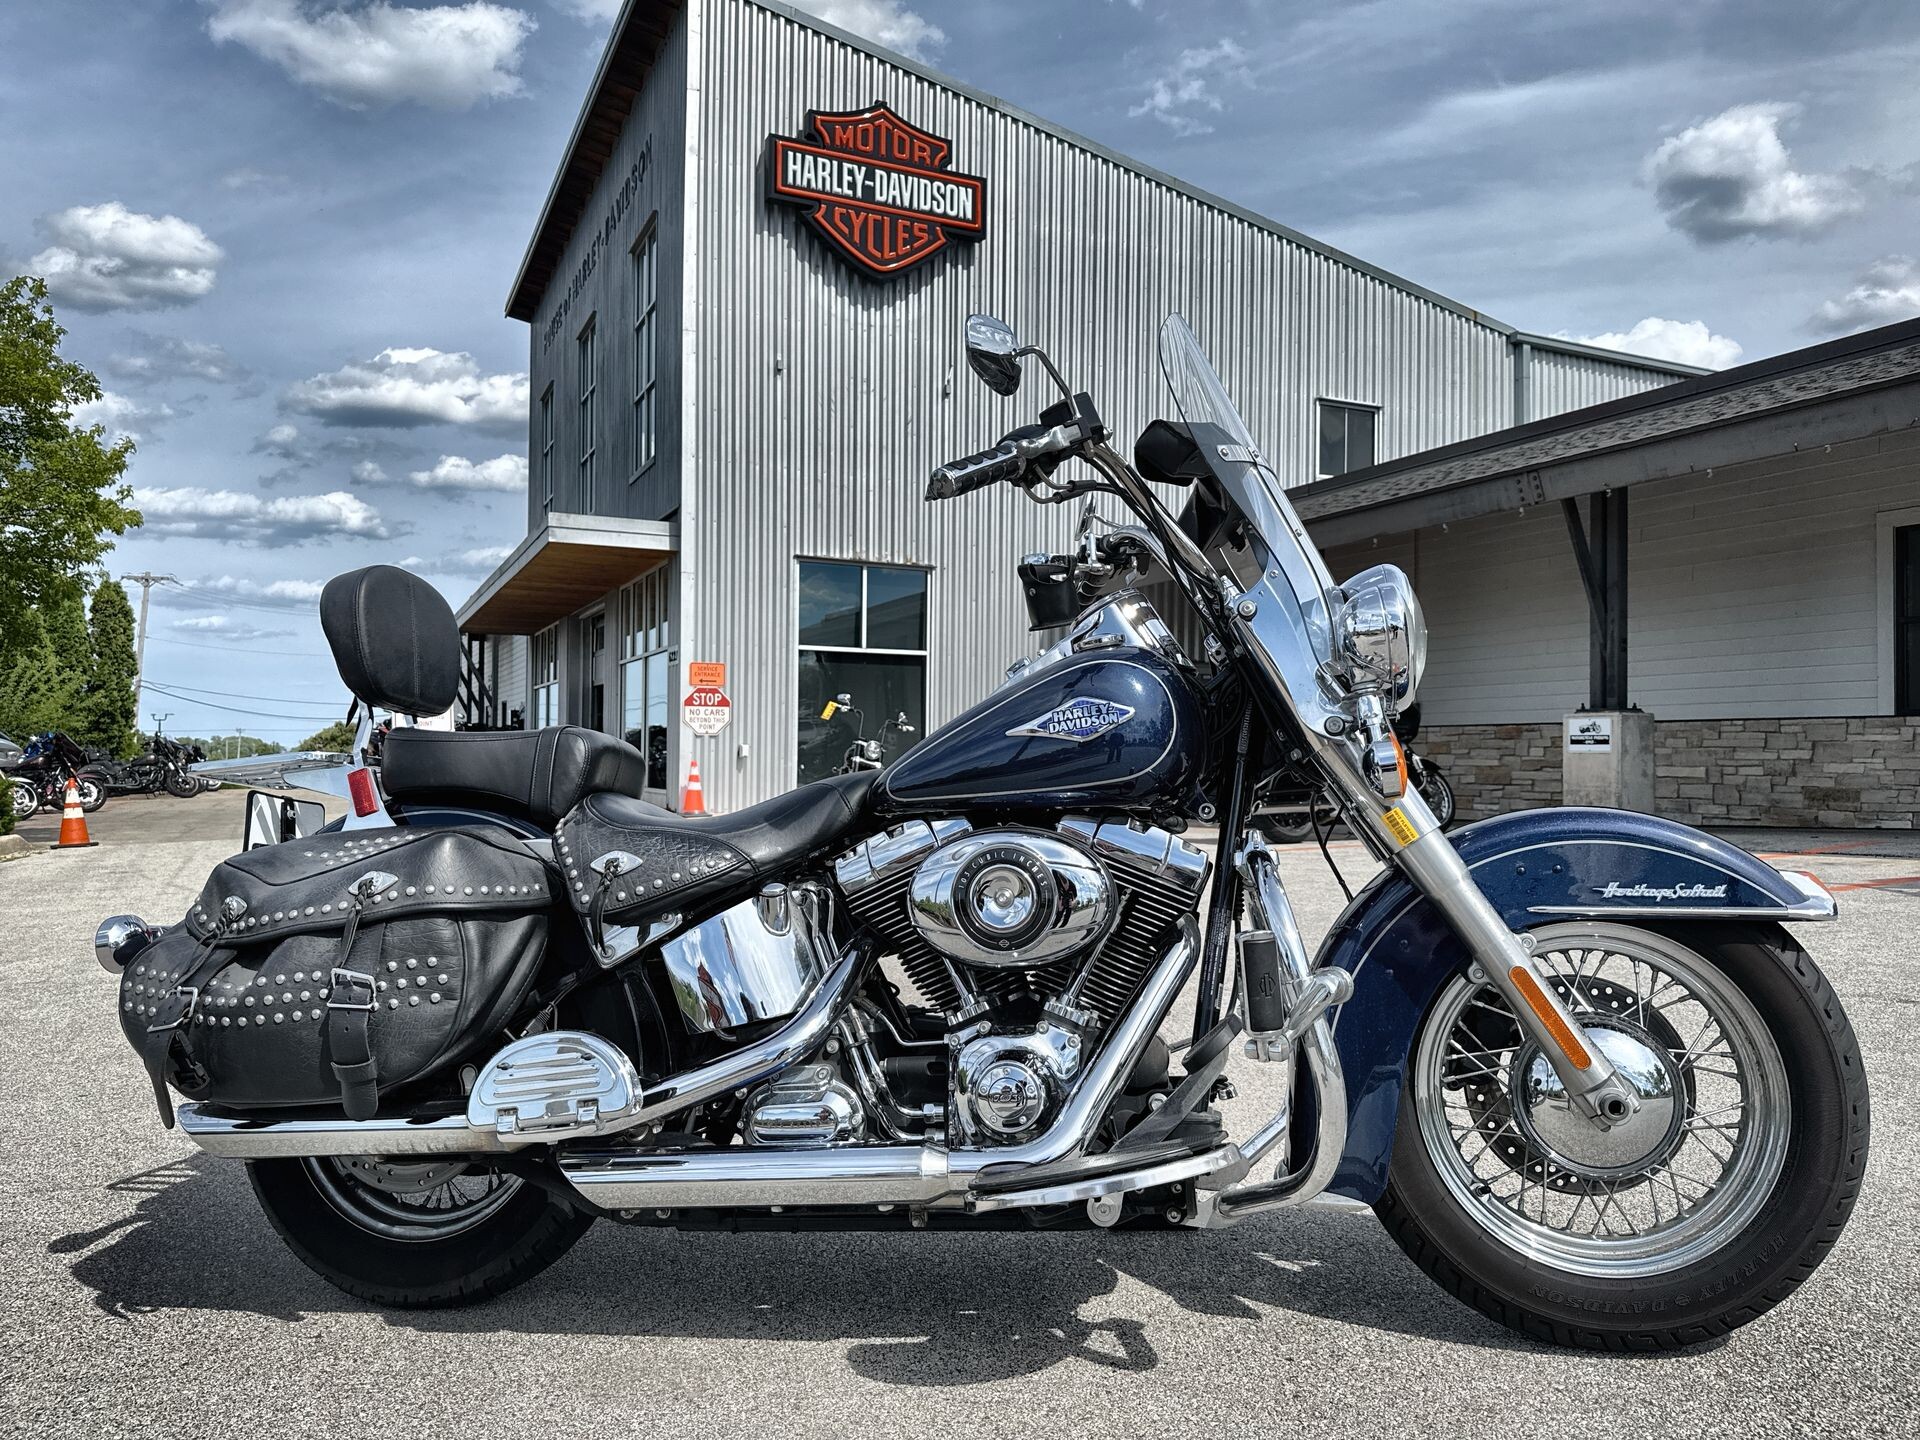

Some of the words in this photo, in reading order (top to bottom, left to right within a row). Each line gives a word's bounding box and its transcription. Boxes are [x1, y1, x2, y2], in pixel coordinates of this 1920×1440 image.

[834, 118, 931, 168] MOTOR
[786, 150, 973, 221] HARLEY-DAVIDSON
[833, 206, 929, 259] CYCLES
[689, 708, 701, 716] NO
[704, 708, 726, 716] CARS
[692, 692, 722, 706] STOP
[1048, 712, 1119, 733] DAVIDSON
[958, 871, 971, 889] 103
[971, 851, 1005, 869] CUBIC
[1012, 853, 1047, 887] INCHES
